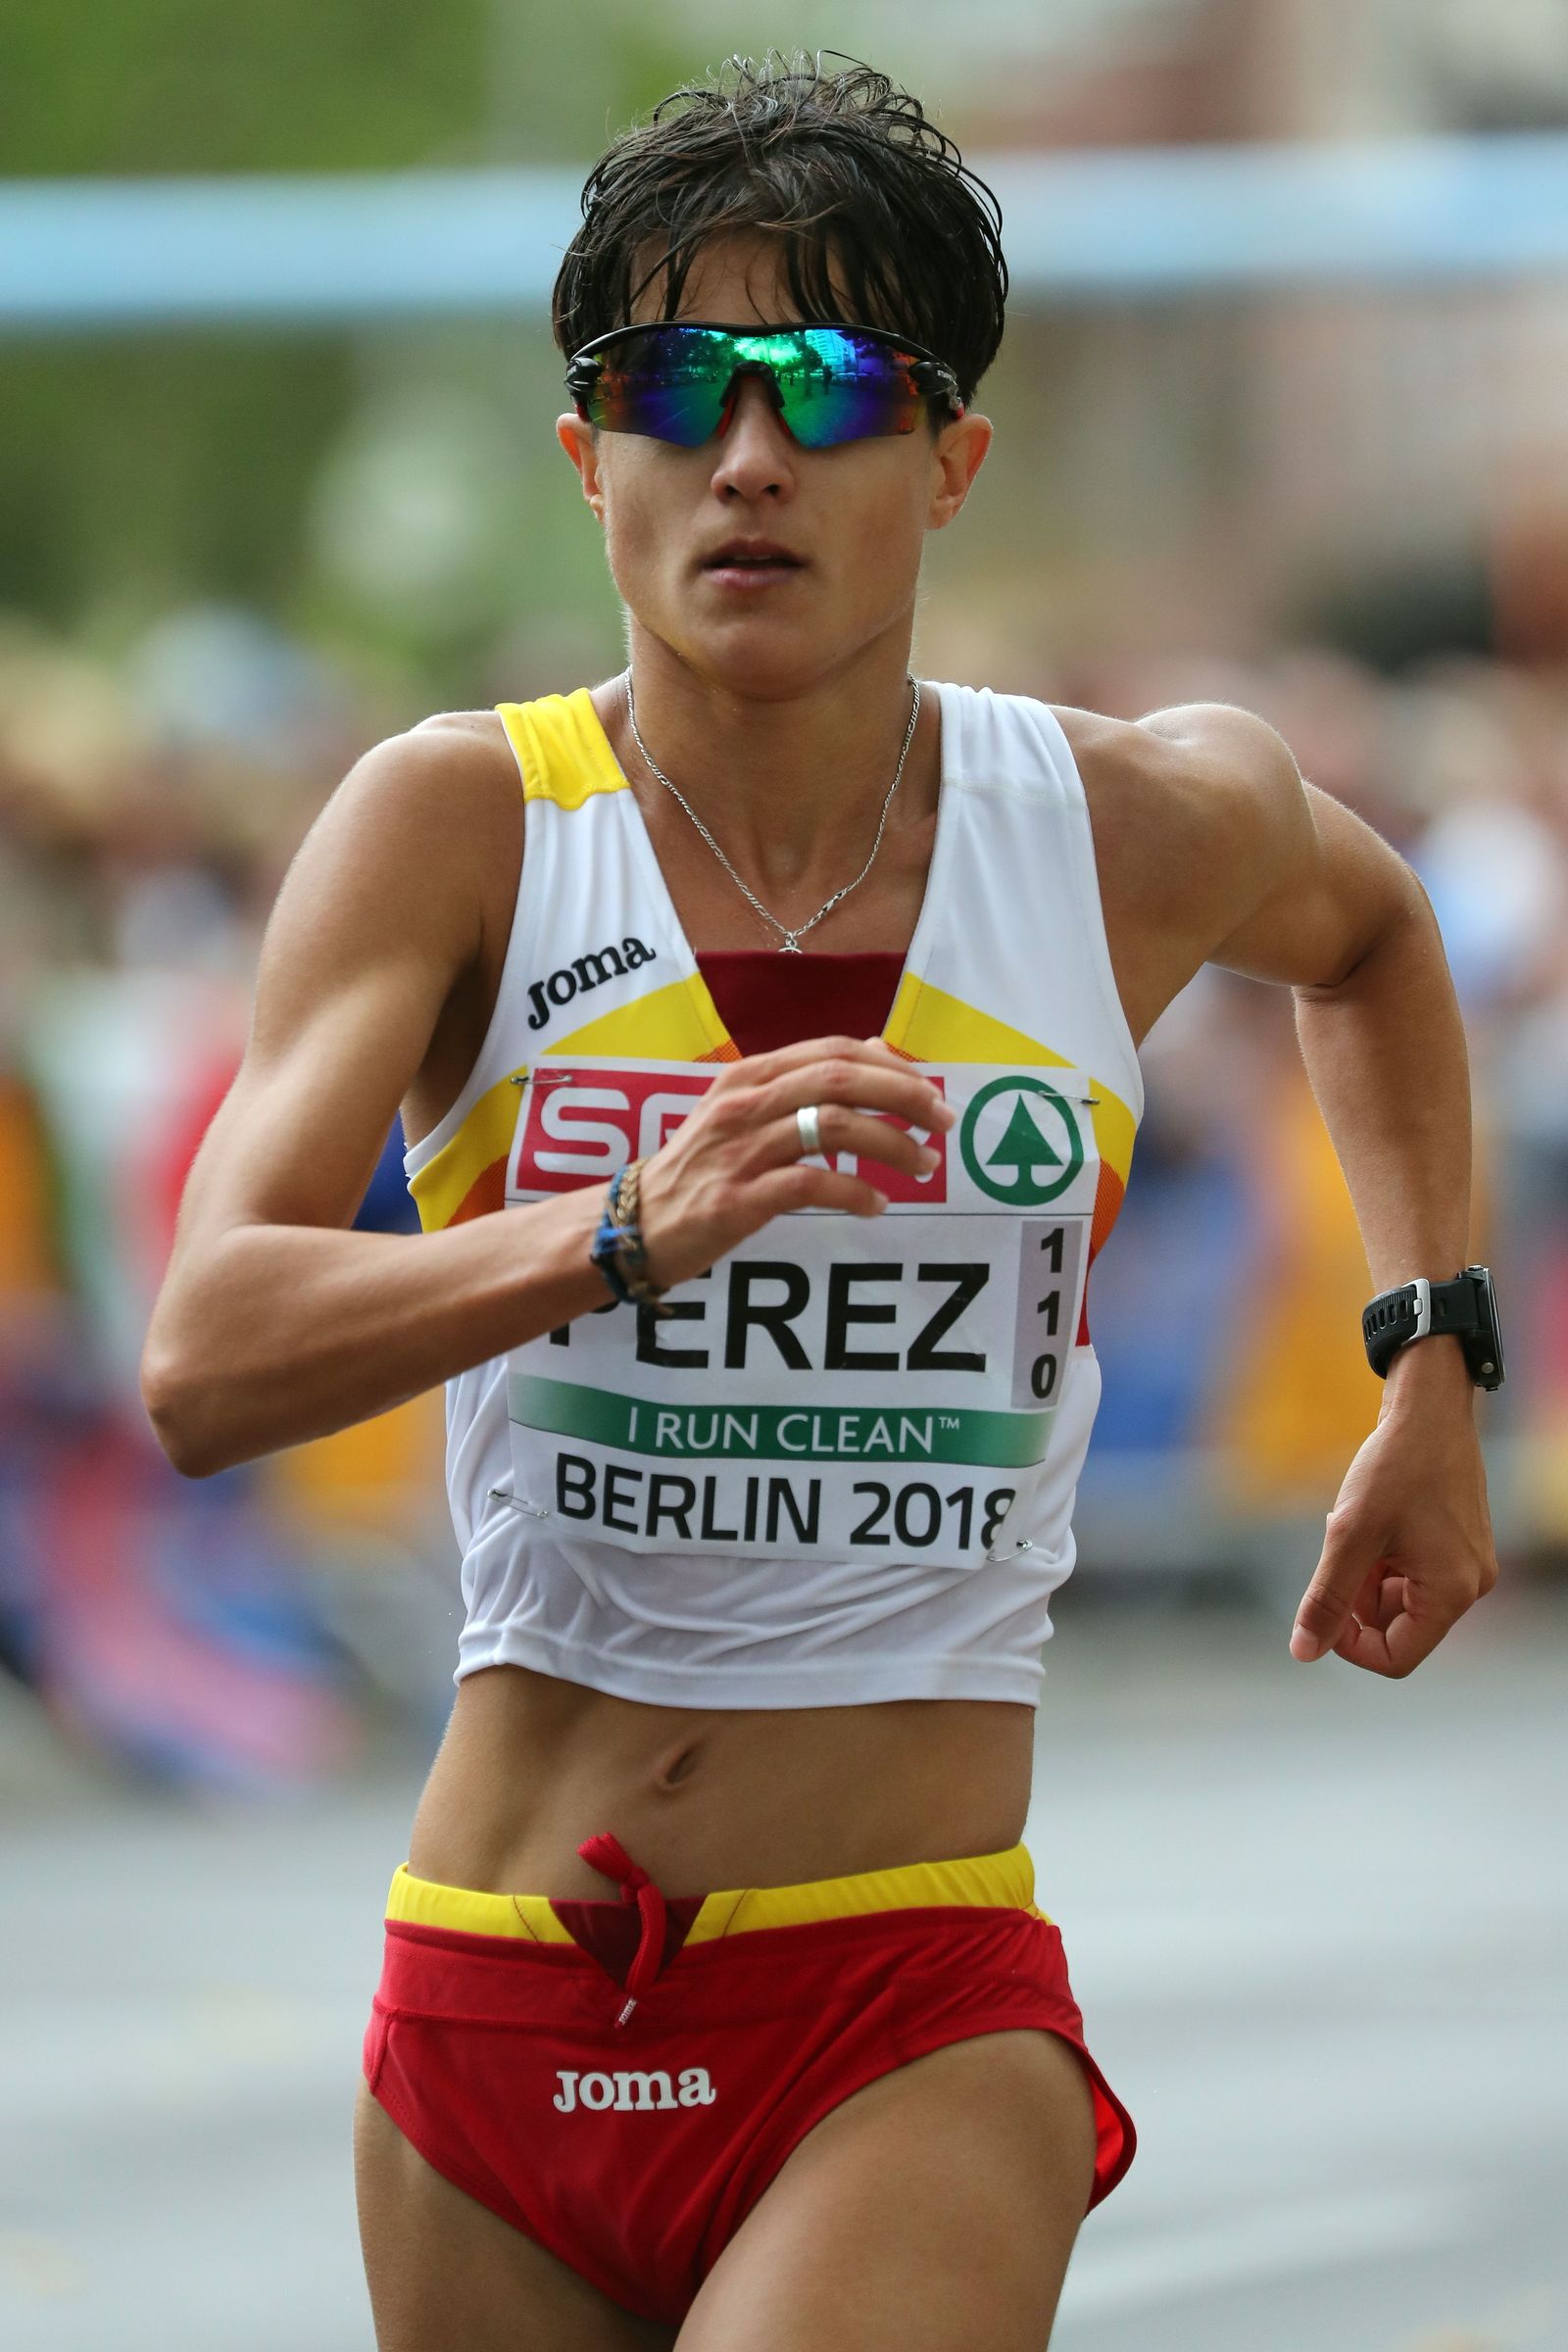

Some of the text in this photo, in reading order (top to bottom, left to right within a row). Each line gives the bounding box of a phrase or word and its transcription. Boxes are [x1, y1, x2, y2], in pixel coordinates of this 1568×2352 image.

[549, 1260, 990, 1373] EREZ
[628, 1406, 638, 1444] I
[656, 1412, 759, 1450] RUN
[556, 1451, 822, 1544] BERLIN
